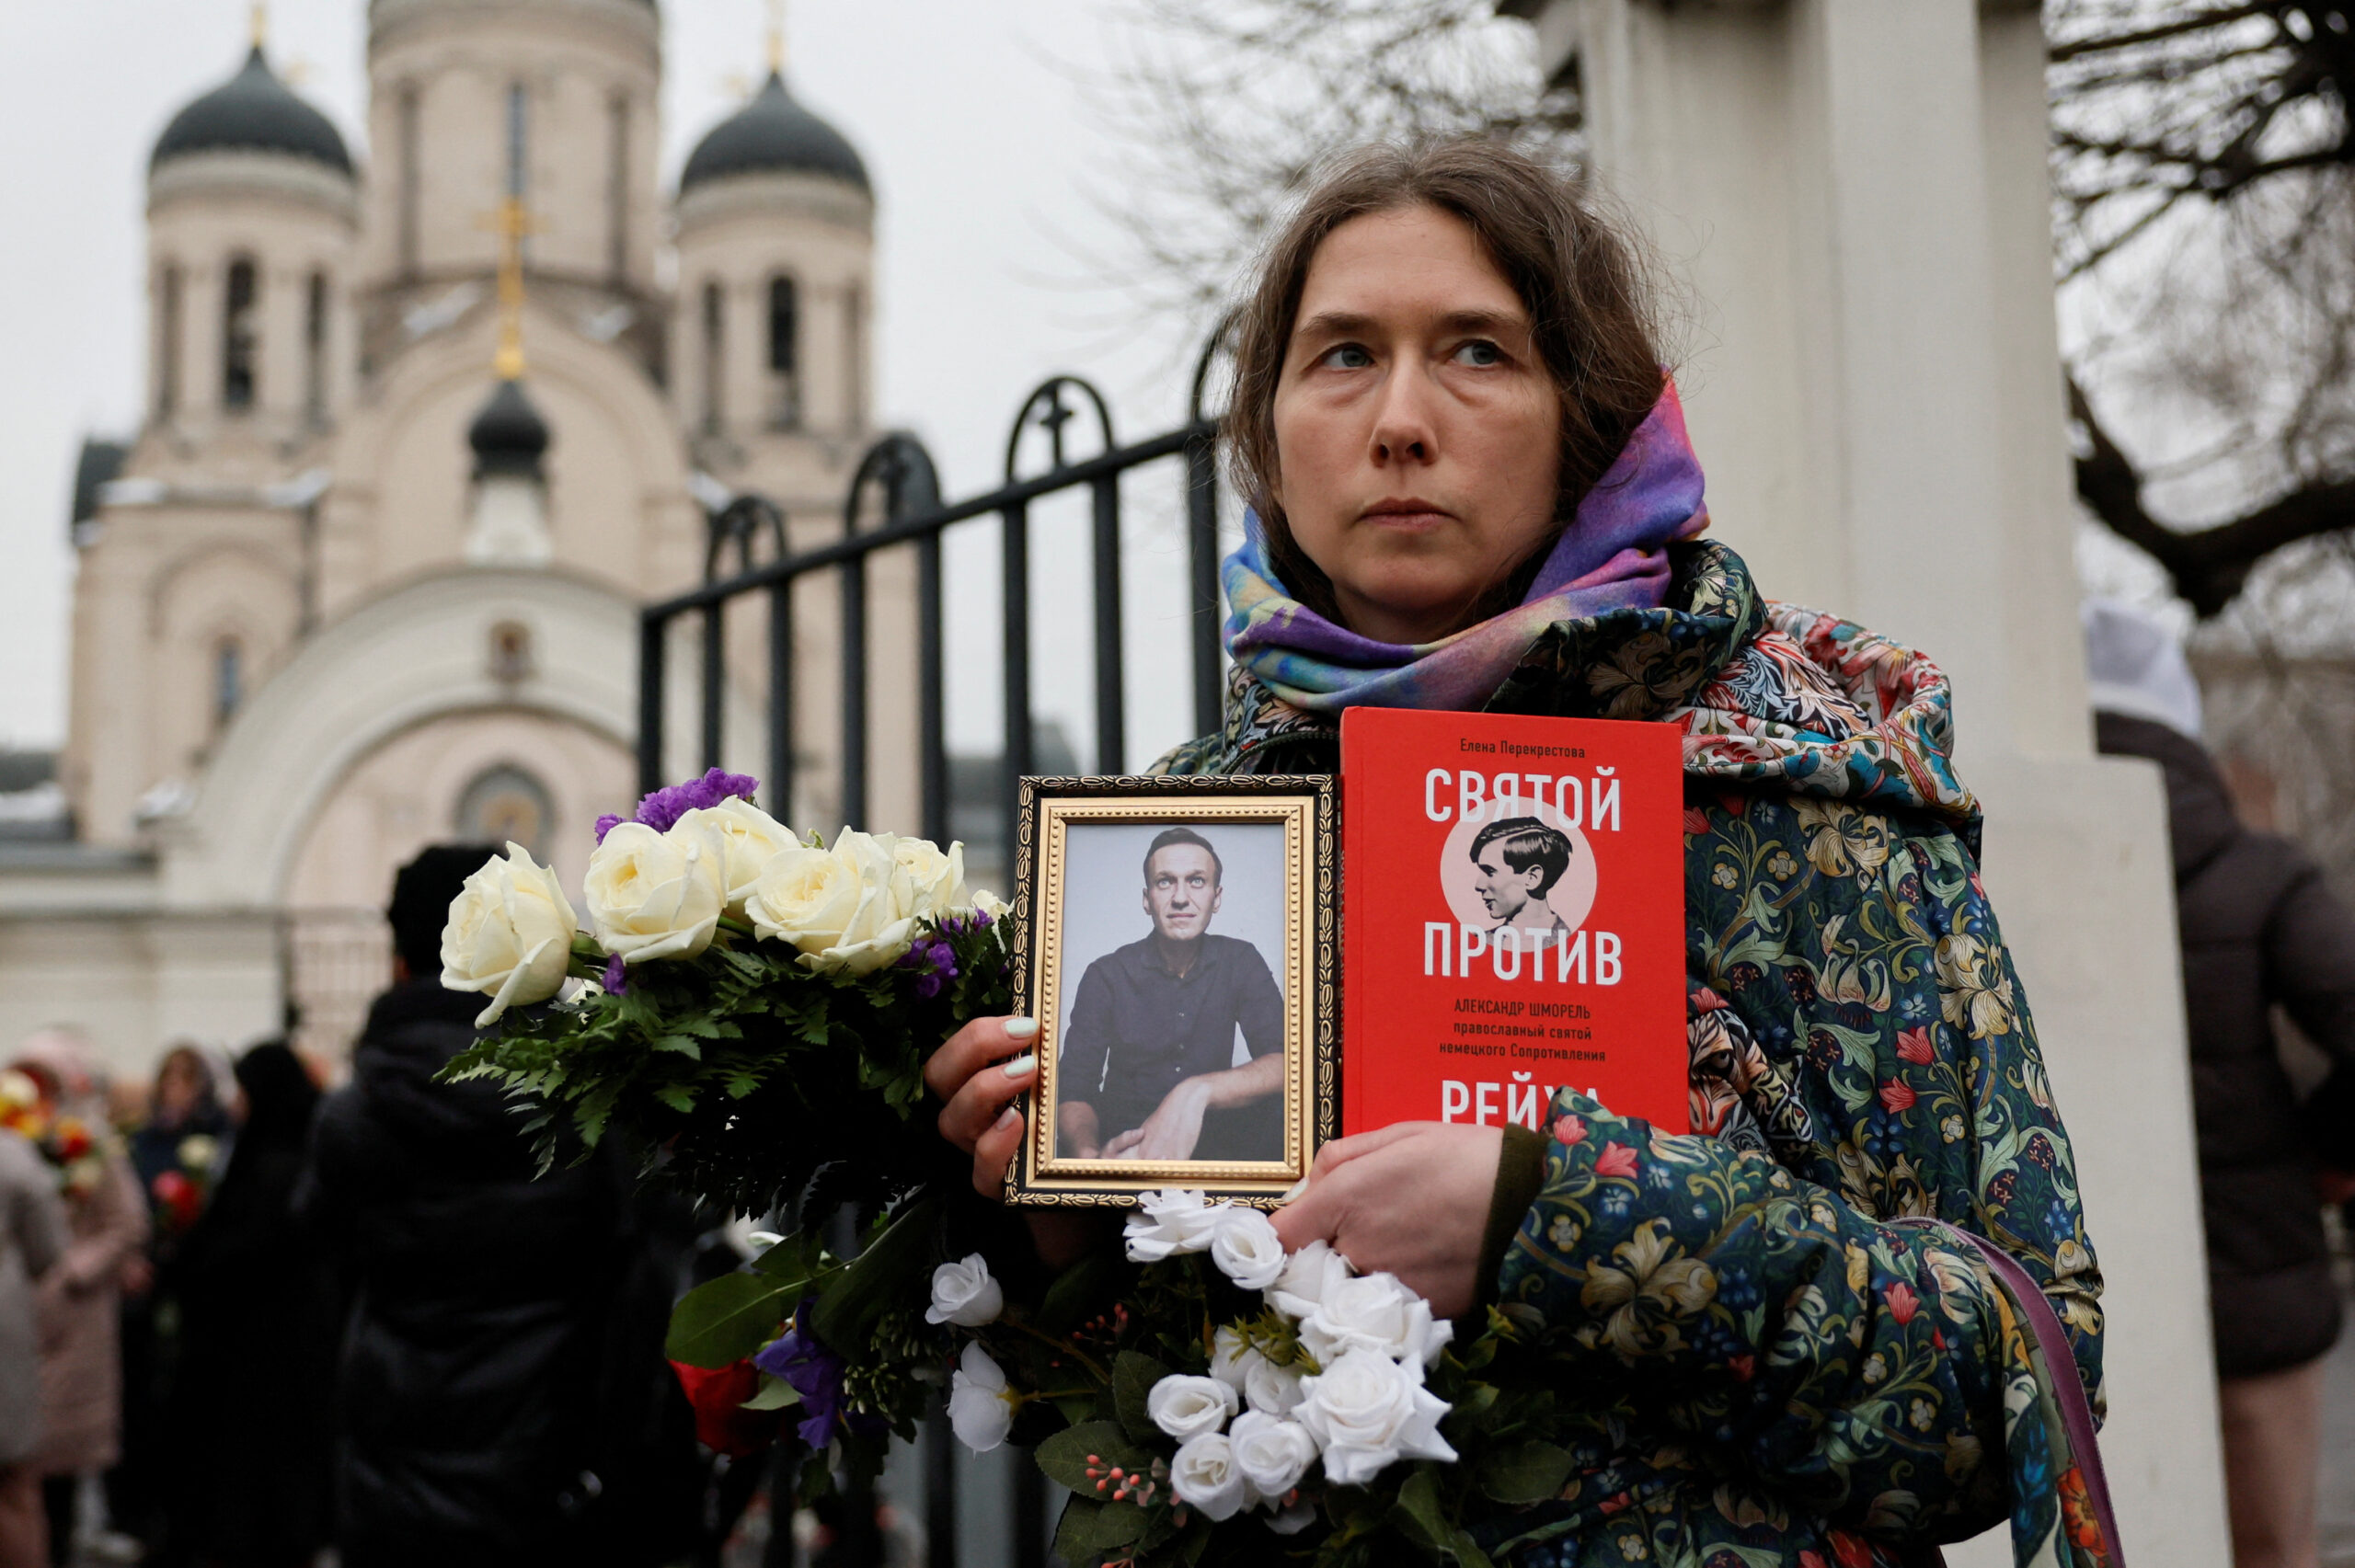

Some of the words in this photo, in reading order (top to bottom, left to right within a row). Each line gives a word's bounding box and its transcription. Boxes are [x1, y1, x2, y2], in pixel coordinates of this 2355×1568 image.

[1460, 738, 1496, 753] Елена
[1500, 740, 1586, 759] Перекрестова
[1425, 766, 1620, 831] СВЯТОЙ
[1424, 921, 1622, 986] ПРОТИВ
[1453, 999, 1525, 1016] АЛЕКСАНДР
[1529, 1002, 1591, 1020] ШМОРЕЛЬ
[1453, 1023, 1545, 1037] православный
[1549, 1027, 1591, 1040] святой
[1439, 1043, 1506, 1057] немецкого
[1511, 1043, 1606, 1061] Сопротивления
[1442, 1070, 1599, 1133] РЕЙ
